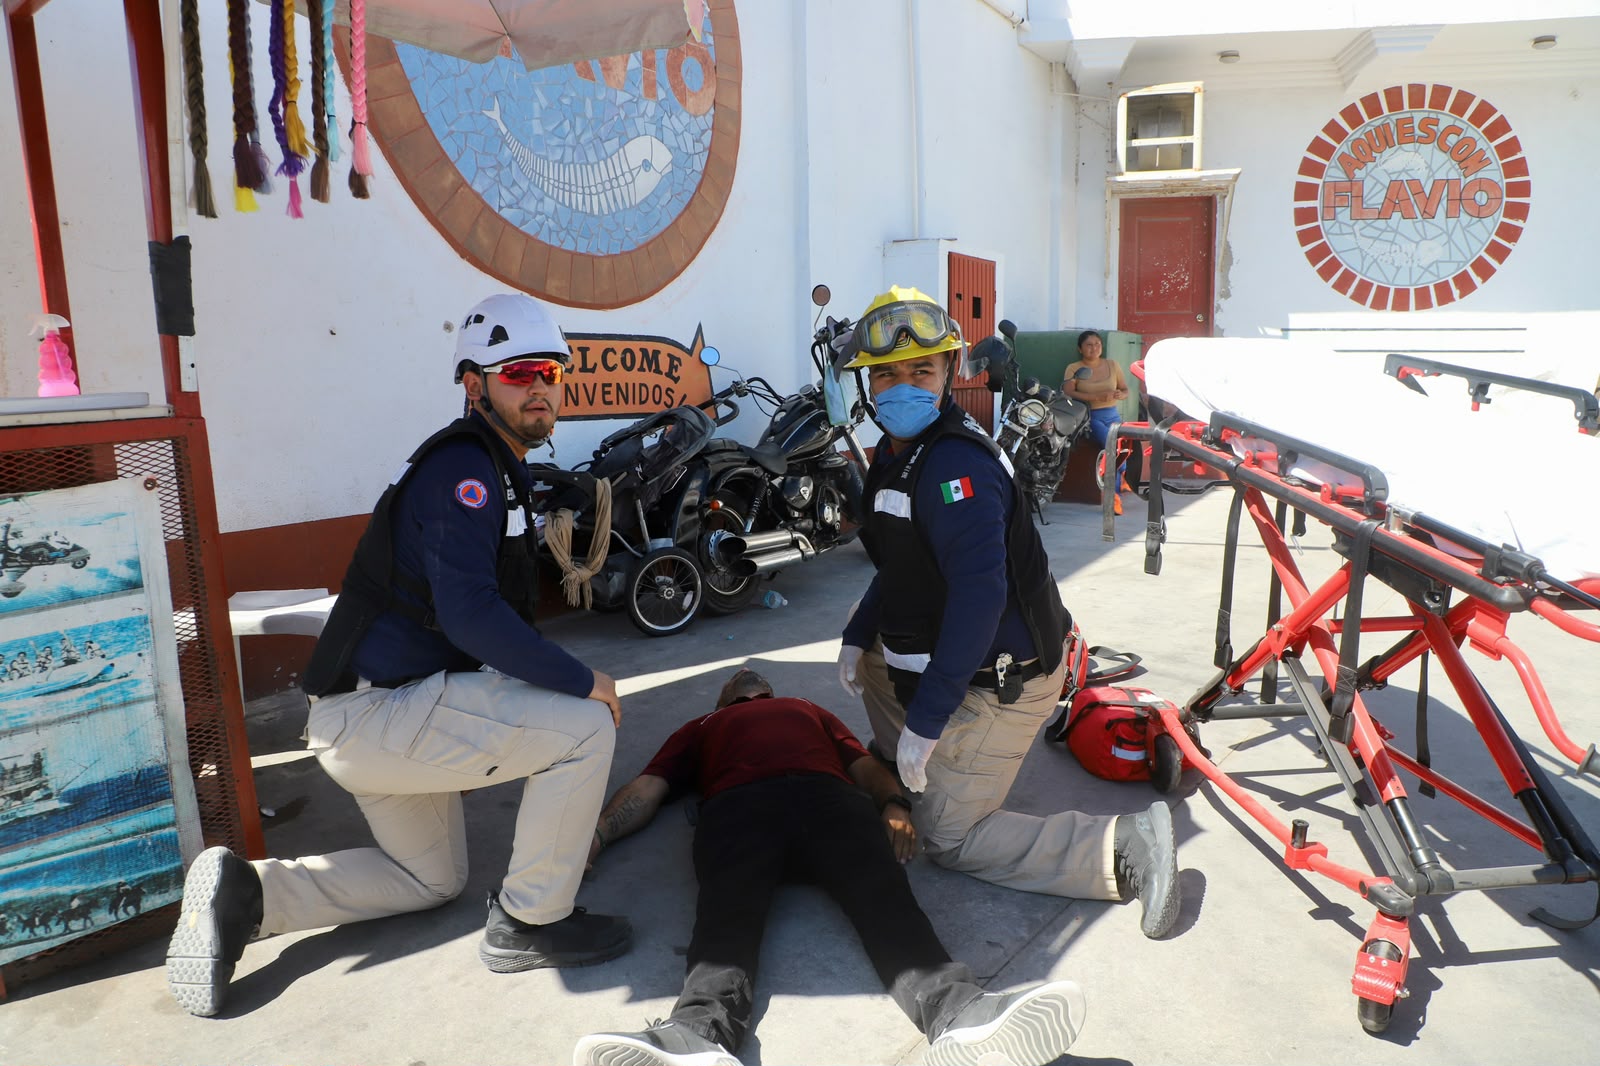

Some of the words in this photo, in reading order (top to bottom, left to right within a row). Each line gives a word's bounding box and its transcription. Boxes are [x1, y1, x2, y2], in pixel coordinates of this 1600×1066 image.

[1322, 177, 1504, 221] FLAVIO
[564, 345, 683, 384] LCOME
[564, 382, 688, 409] NVENIDOS!
